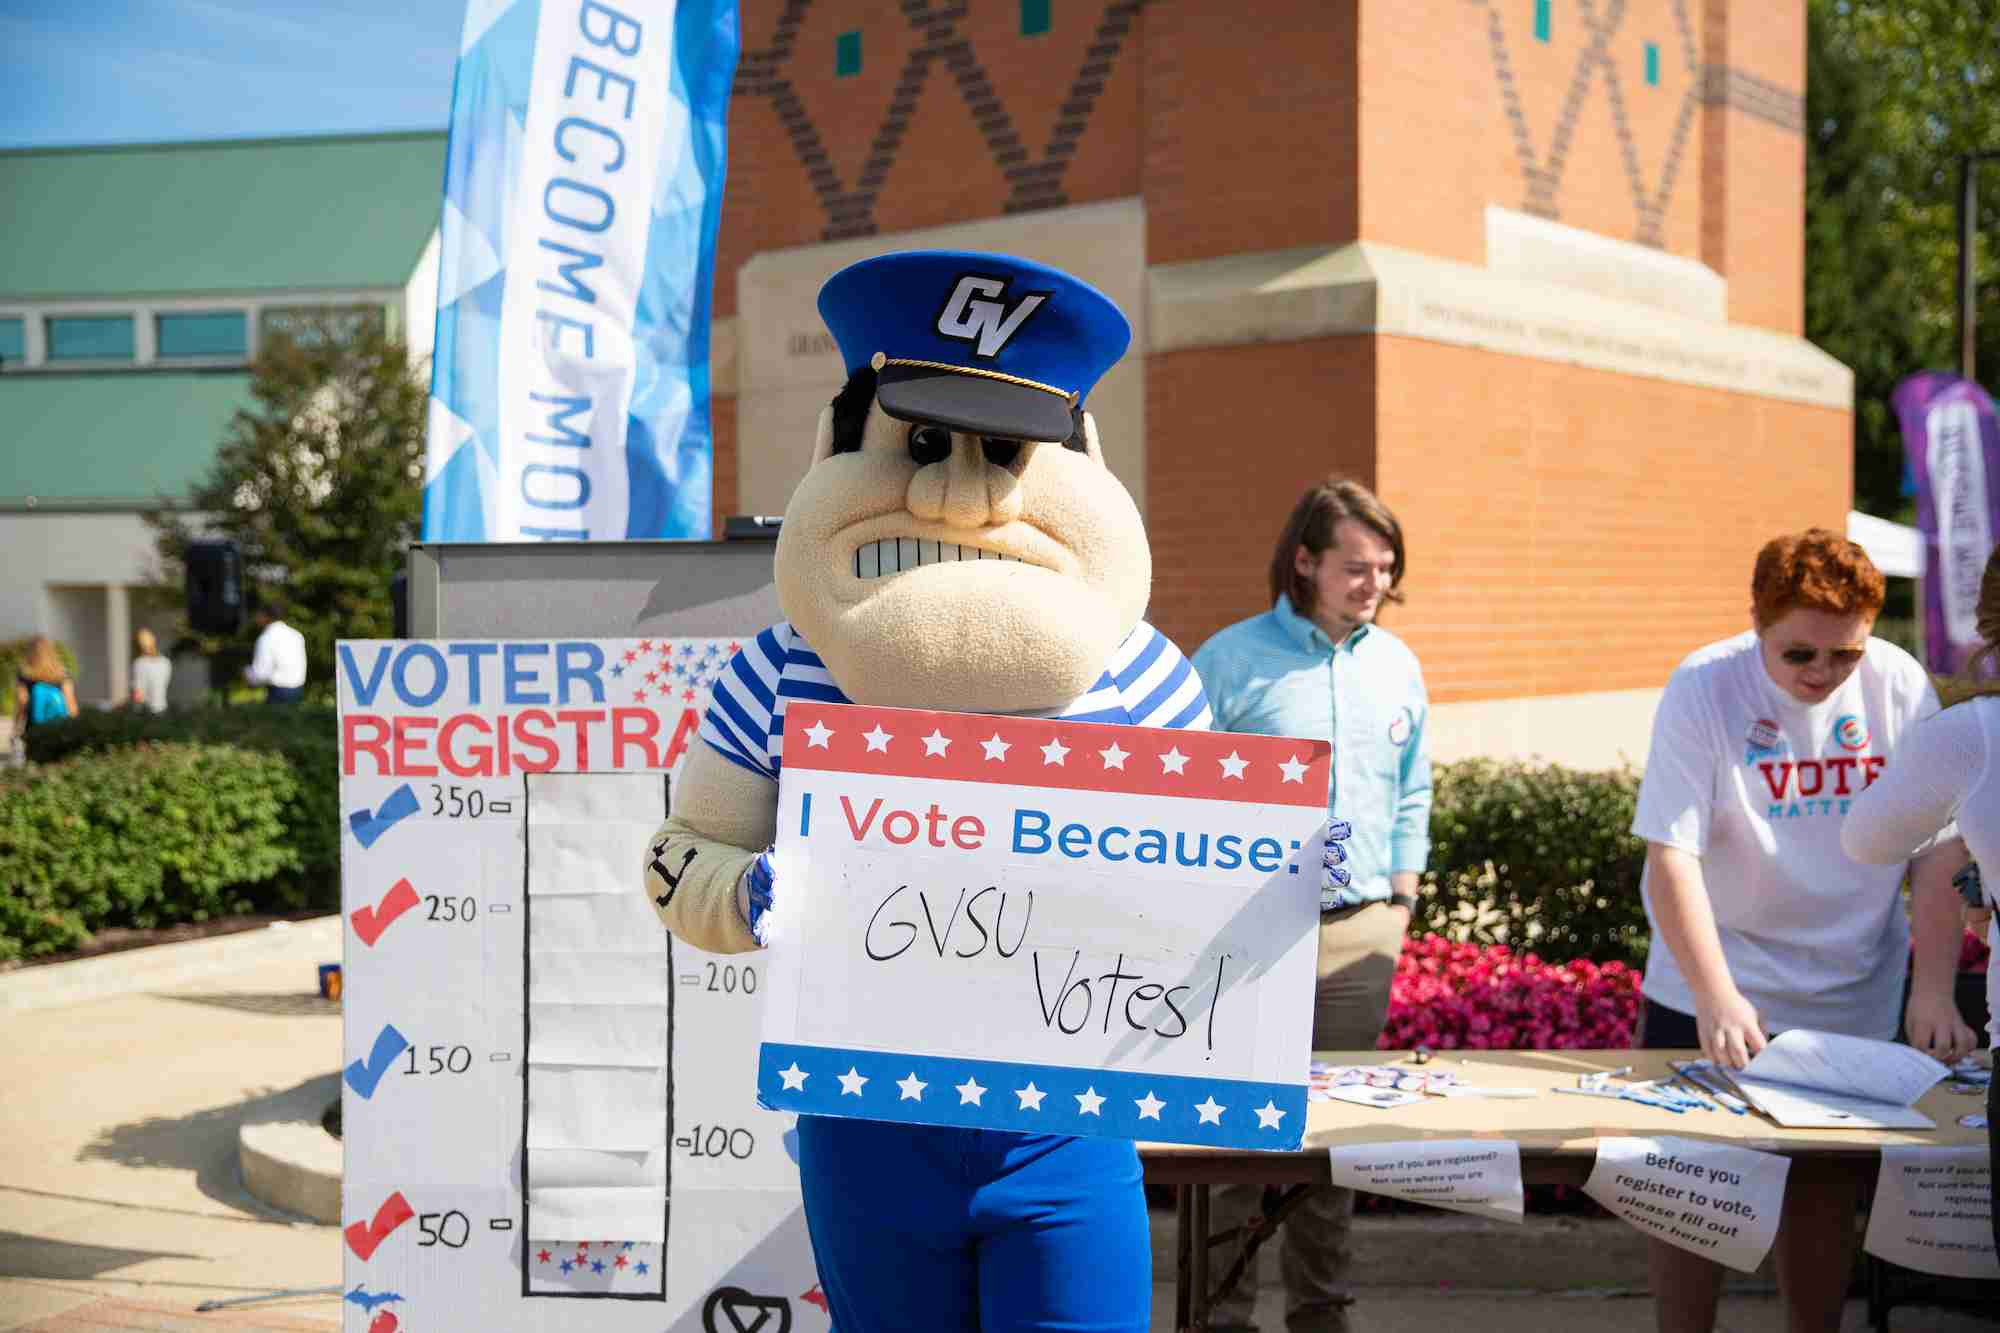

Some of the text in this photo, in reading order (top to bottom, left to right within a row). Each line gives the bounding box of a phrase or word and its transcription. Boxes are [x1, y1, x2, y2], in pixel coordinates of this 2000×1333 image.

[937, 275, 1047, 357] GV
[338, 642, 606, 707] VOTER
[1758, 756, 1886, 799] VOTE
[431, 784, 485, 818] 350
[799, 792, 1301, 874] I Vote Because:
[423, 895, 478, 922] 250
[864, 885, 1034, 961] GVSU
[706, 961, 758, 993] 200
[1032, 950, 1222, 1061] Votes!
[403, 1044, 472, 1076] 150
[689, 1125, 755, 1160] 100
[1407, 1161, 1425, 1170] you
[1427, 1158, 1442, 1167] are
[1444, 1151, 1498, 1166] registered?
[1645, 1152, 1741, 1185] Before you
[1615, 1174, 1758, 1221] register to vote,
[1616, 1194, 1739, 1238] please fill out
[417, 1209, 471, 1248] 50
[1623, 1210, 1720, 1248] form here!
